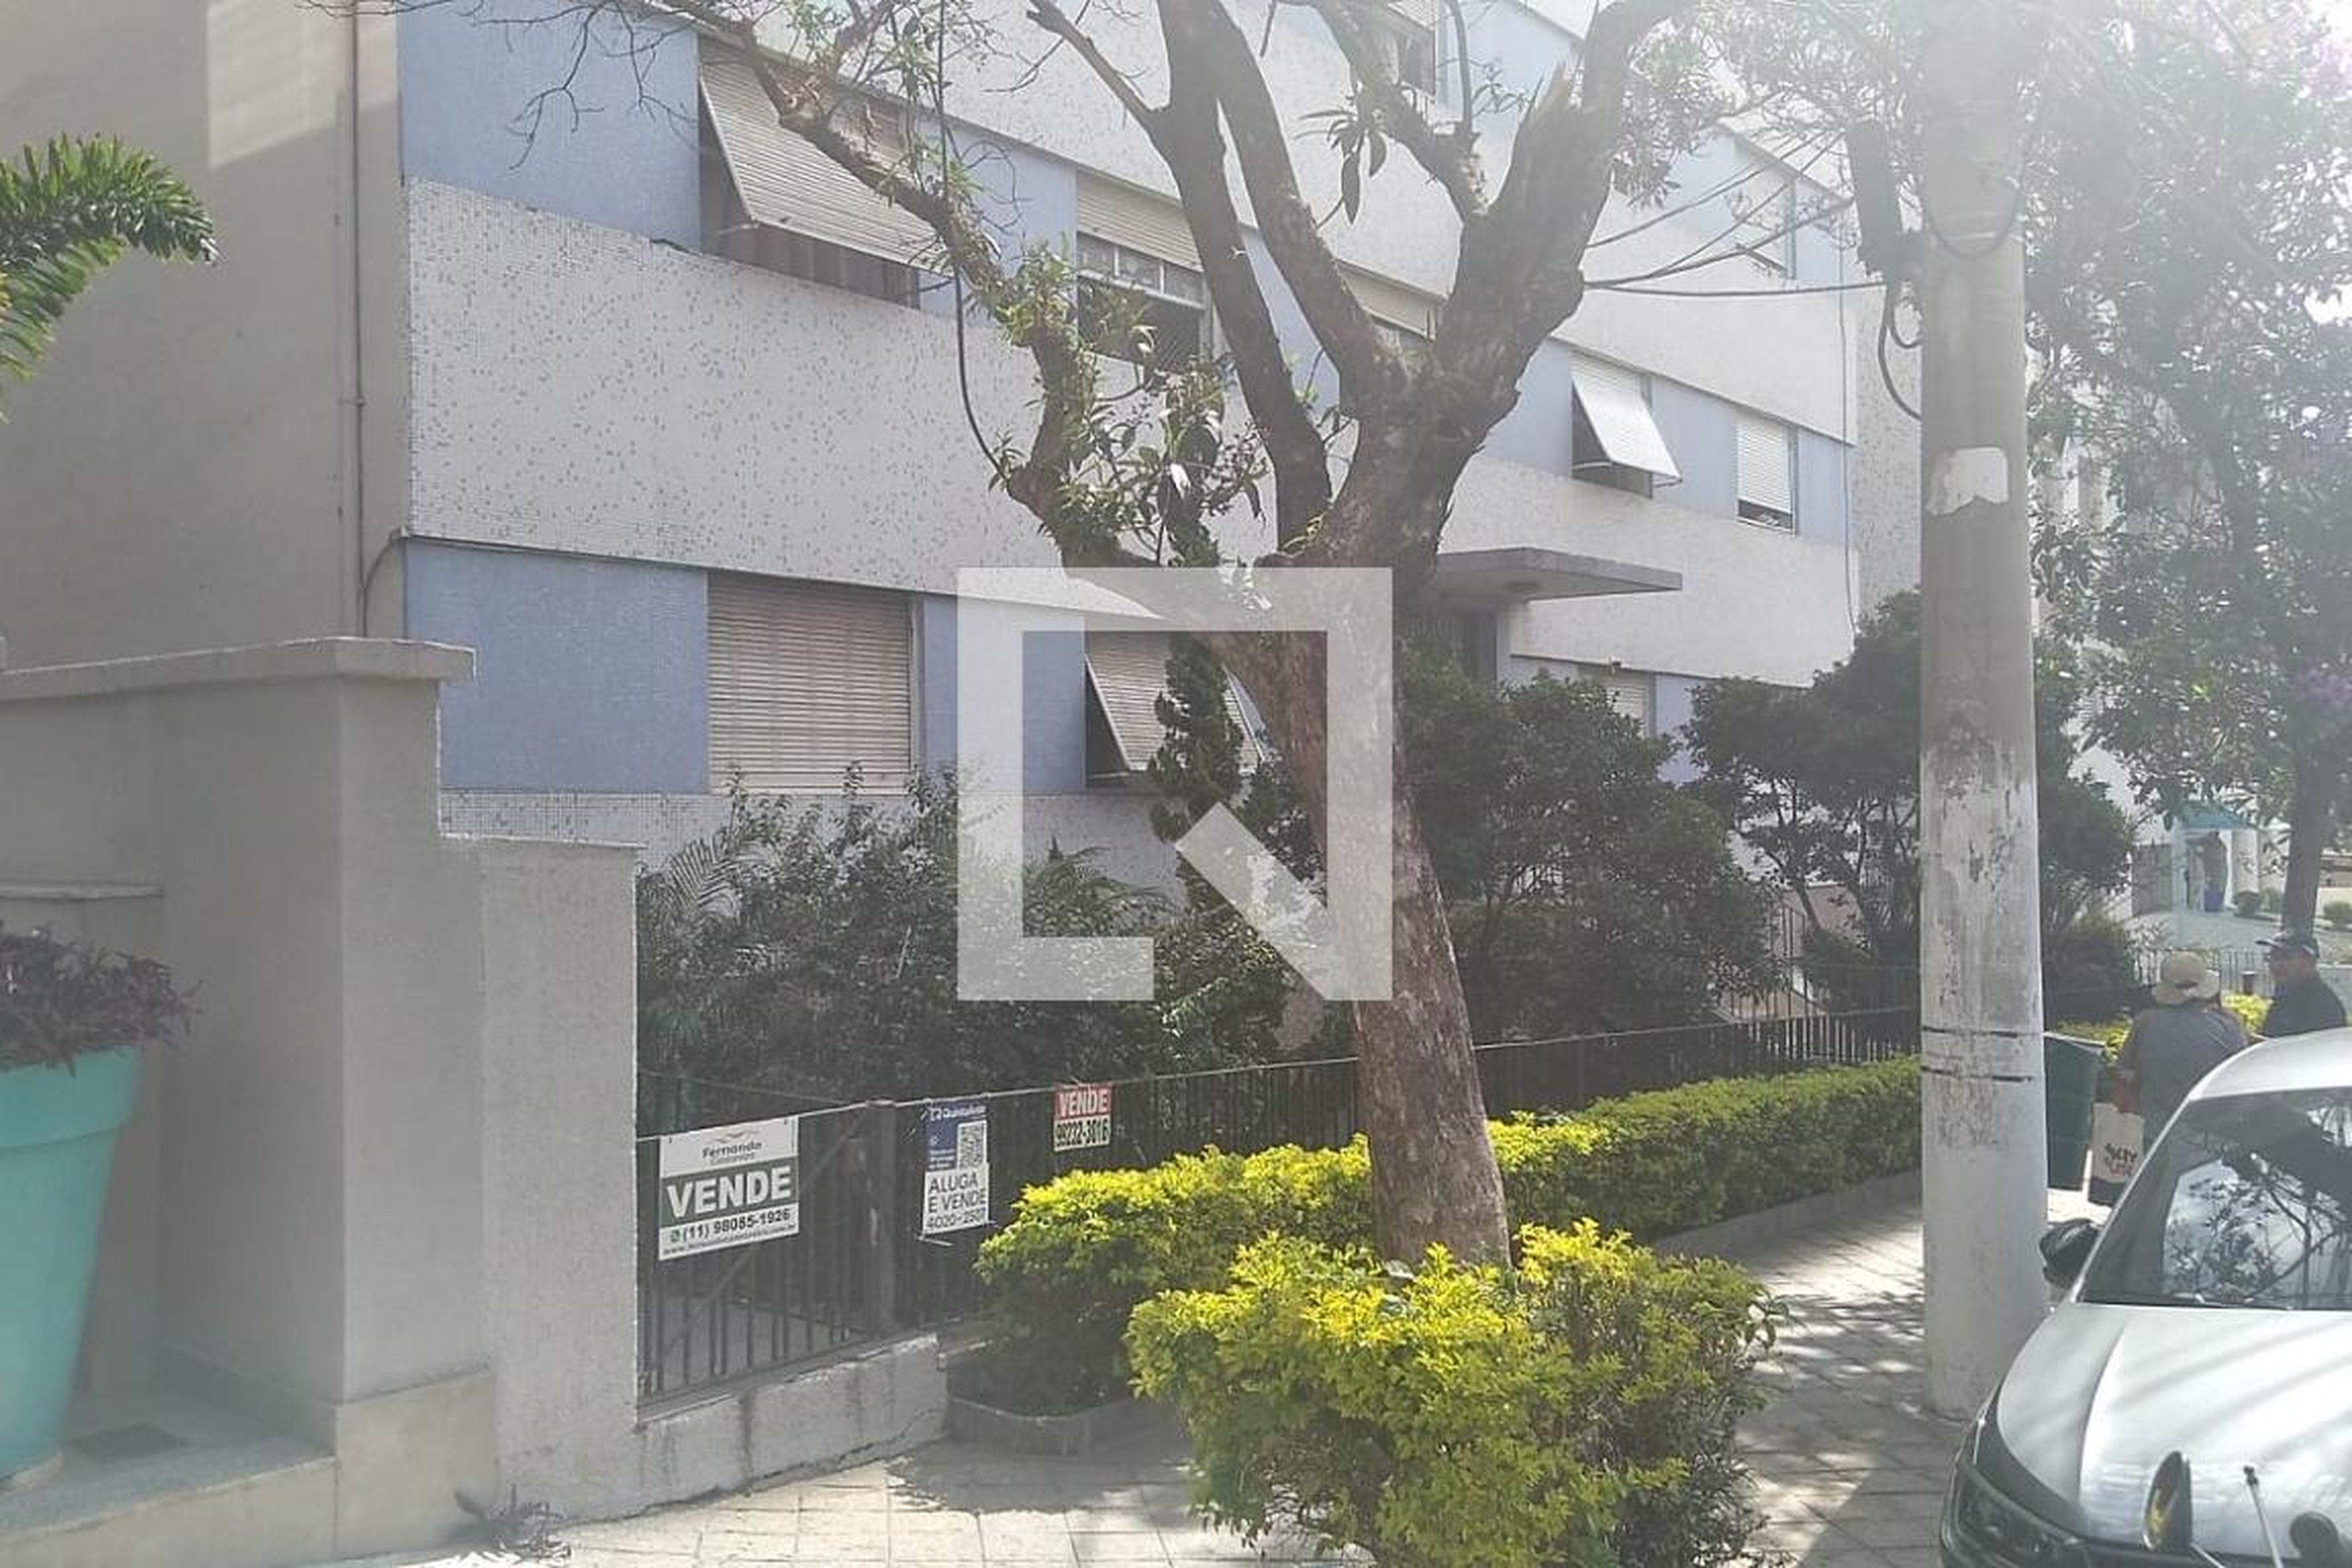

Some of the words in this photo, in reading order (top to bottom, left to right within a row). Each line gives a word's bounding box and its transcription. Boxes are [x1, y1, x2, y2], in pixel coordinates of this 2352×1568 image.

[1058, 1089, 1109, 1117] VENDE
[666, 1165, 791, 1218] VENDE
[929, 1171, 978, 1194] ALUGA
[929, 1196, 937, 1213] E
[941, 1187, 986, 1211] VENDE
[683, 1224, 709, 1242] (11)
